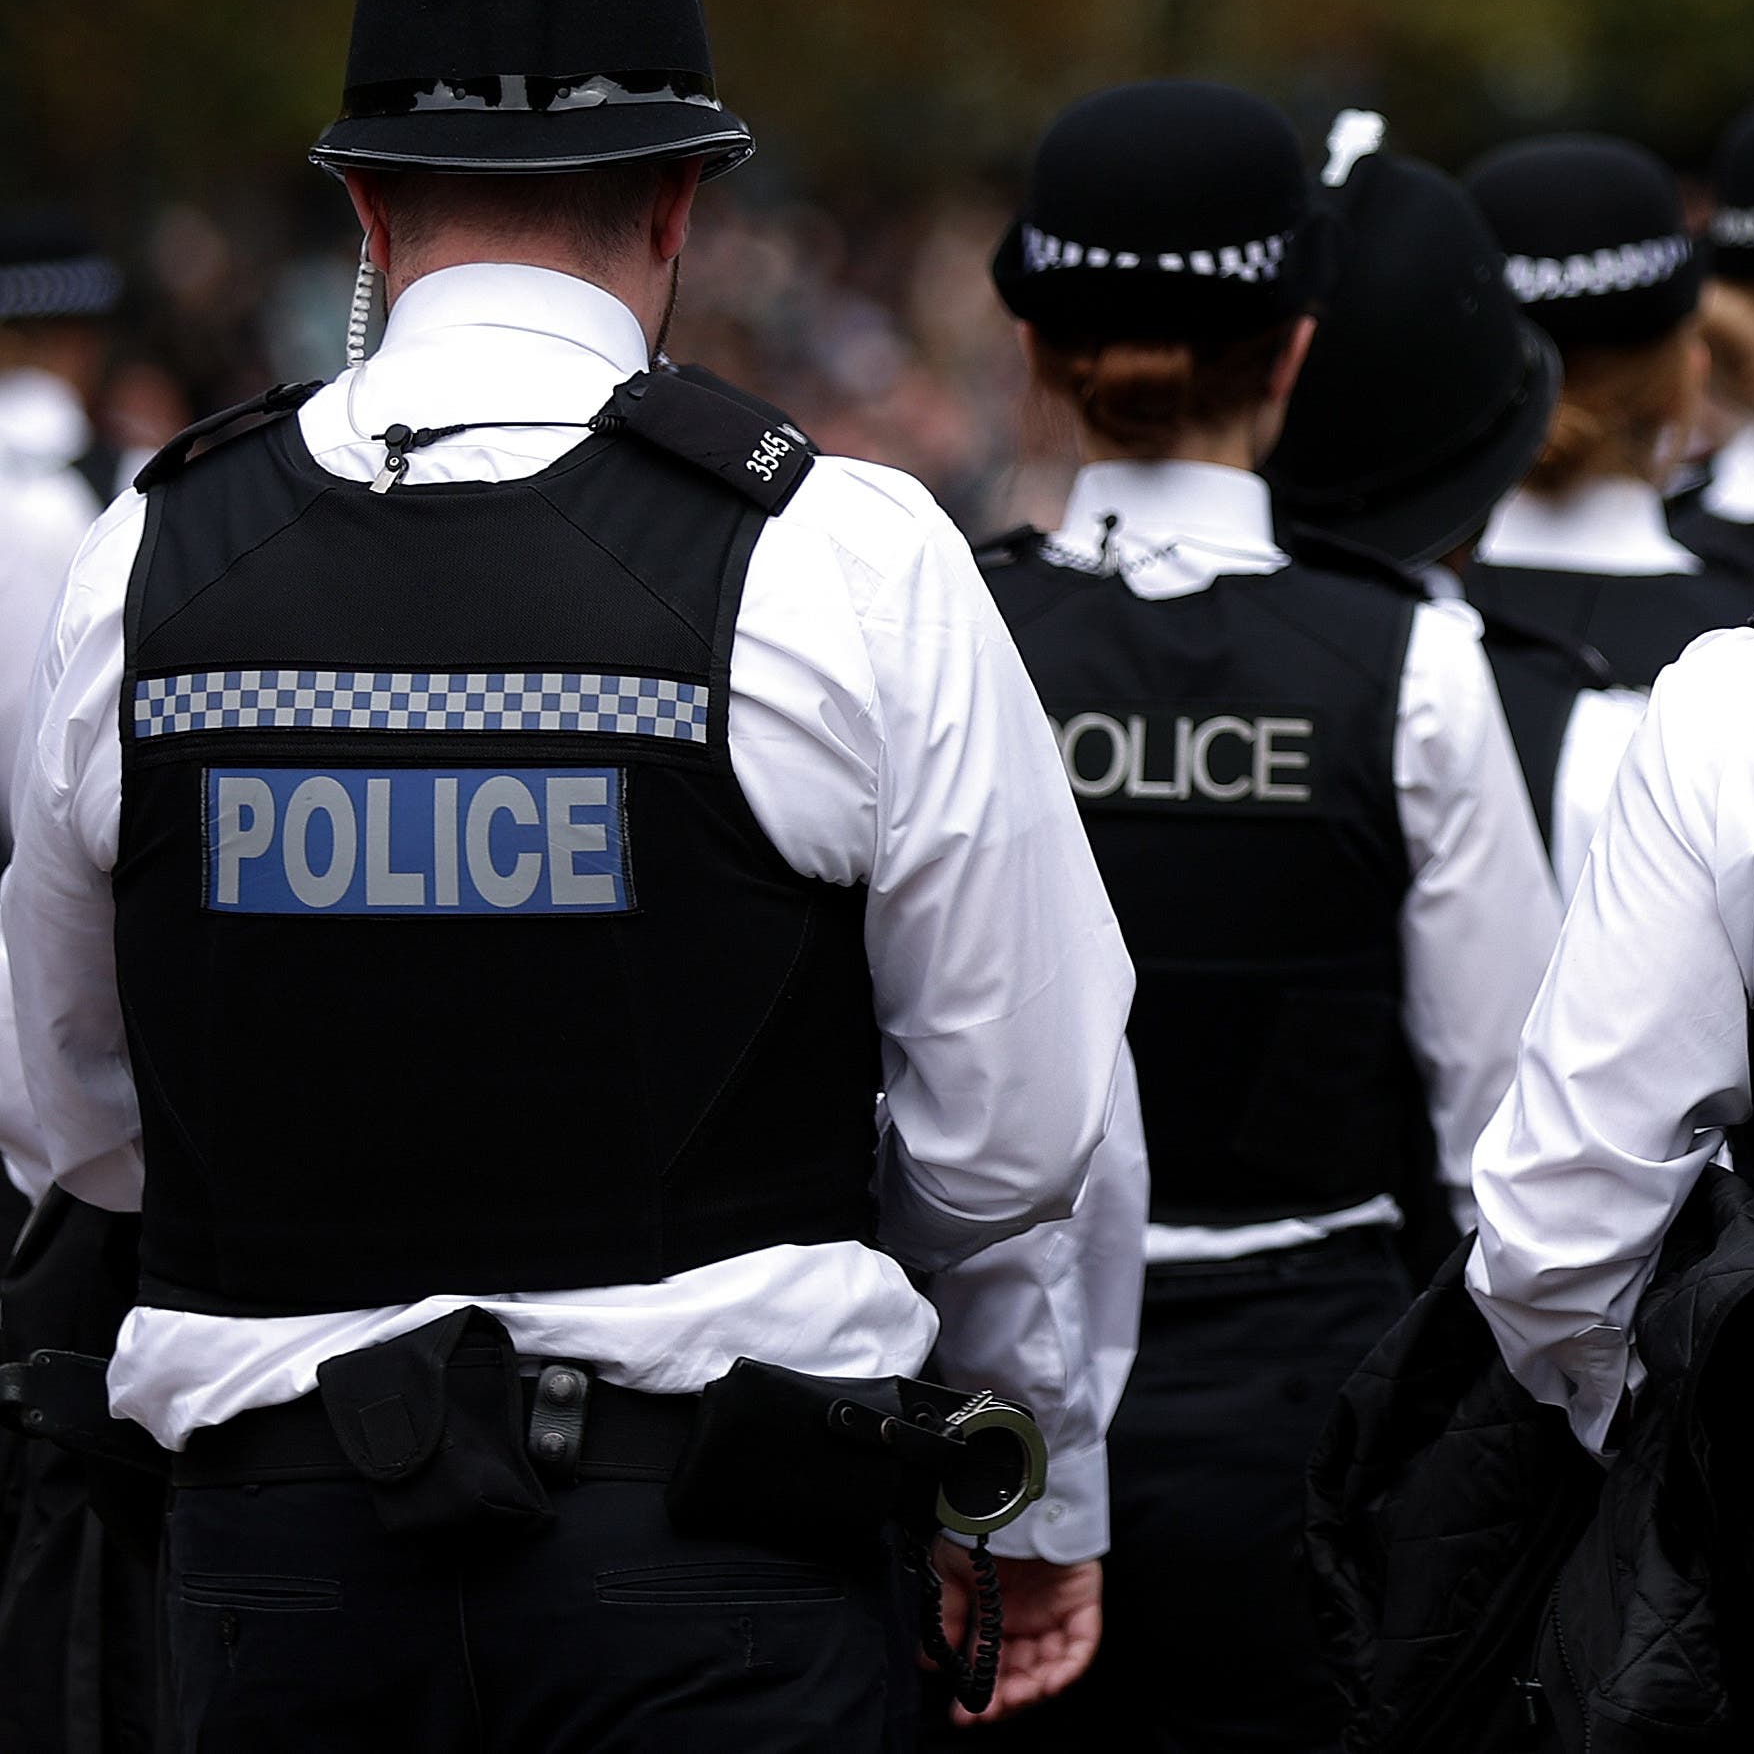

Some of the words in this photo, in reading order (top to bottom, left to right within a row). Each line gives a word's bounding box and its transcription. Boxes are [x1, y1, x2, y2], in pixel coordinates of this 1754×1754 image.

[746, 430, 790, 482] 3545
[1047, 712, 1313, 802] OLICE
[218, 775, 616, 907] POLICE
